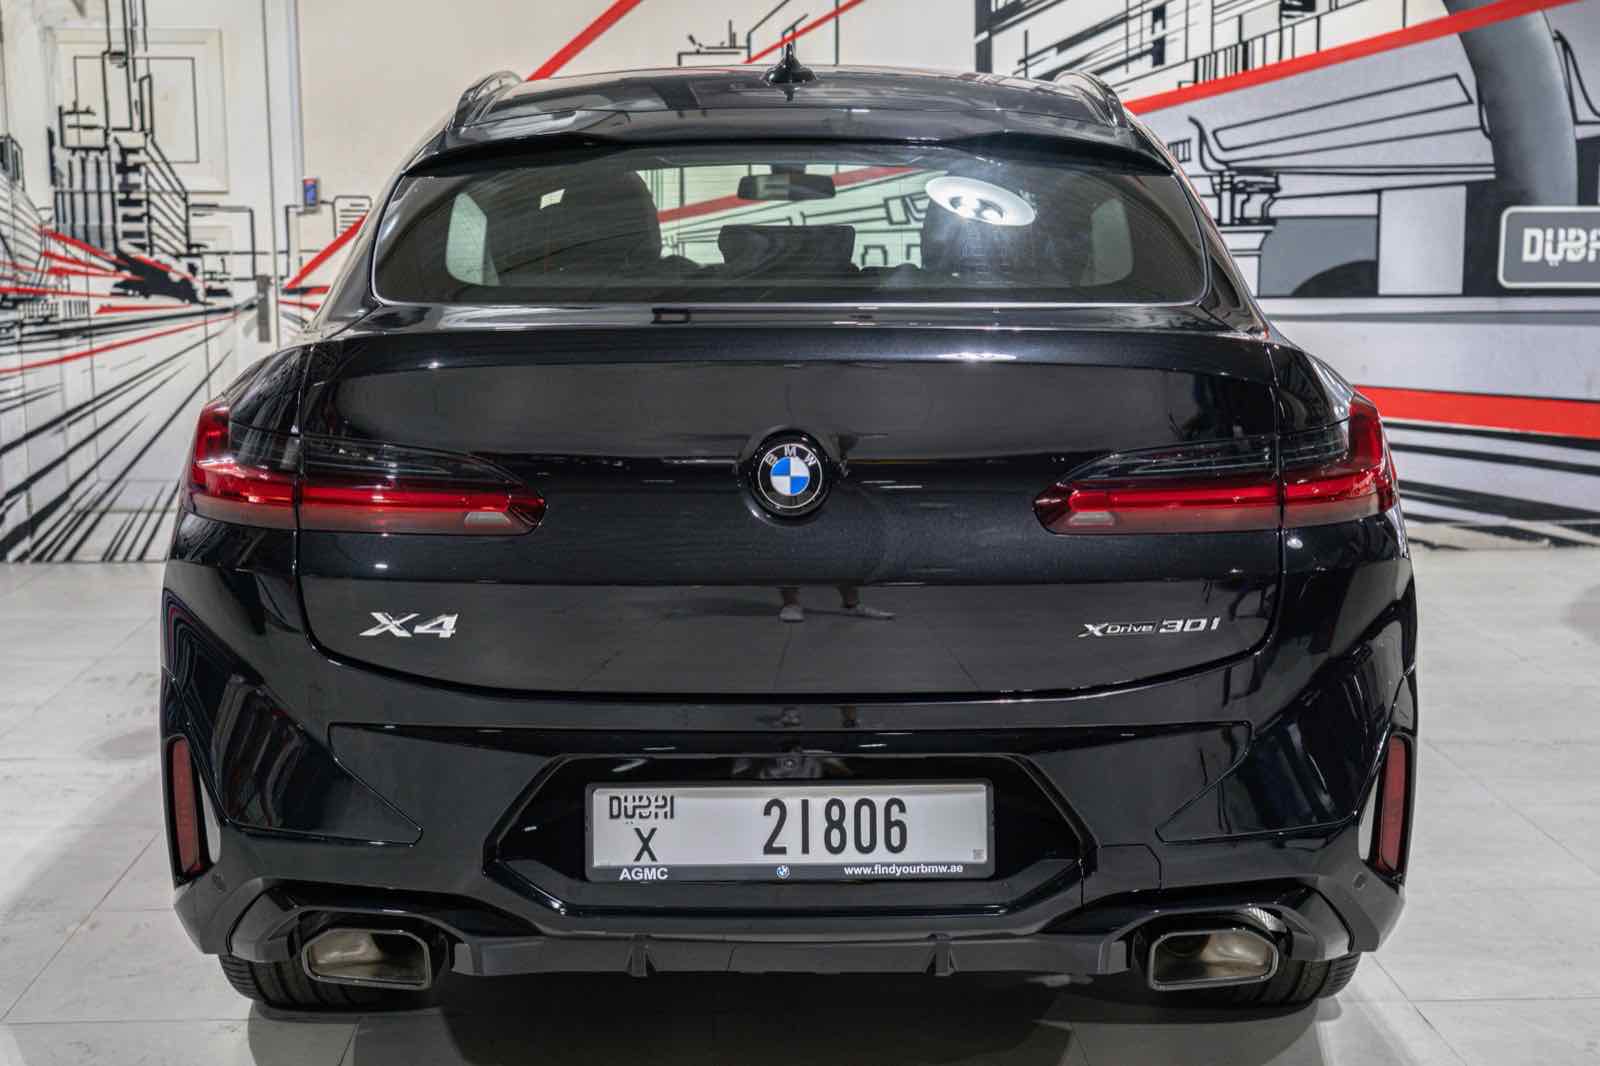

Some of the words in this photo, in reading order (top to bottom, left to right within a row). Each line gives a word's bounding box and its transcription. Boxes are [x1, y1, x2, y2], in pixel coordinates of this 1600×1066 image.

[765, 445, 817, 466] BMW
[359, 611, 458, 638] X4
[763, 798, 908, 855] 21806
[633, 827, 658, 862] X
[619, 867, 669, 880] AGMC
[843, 864, 964, 876] www.findyourbmw.ae
